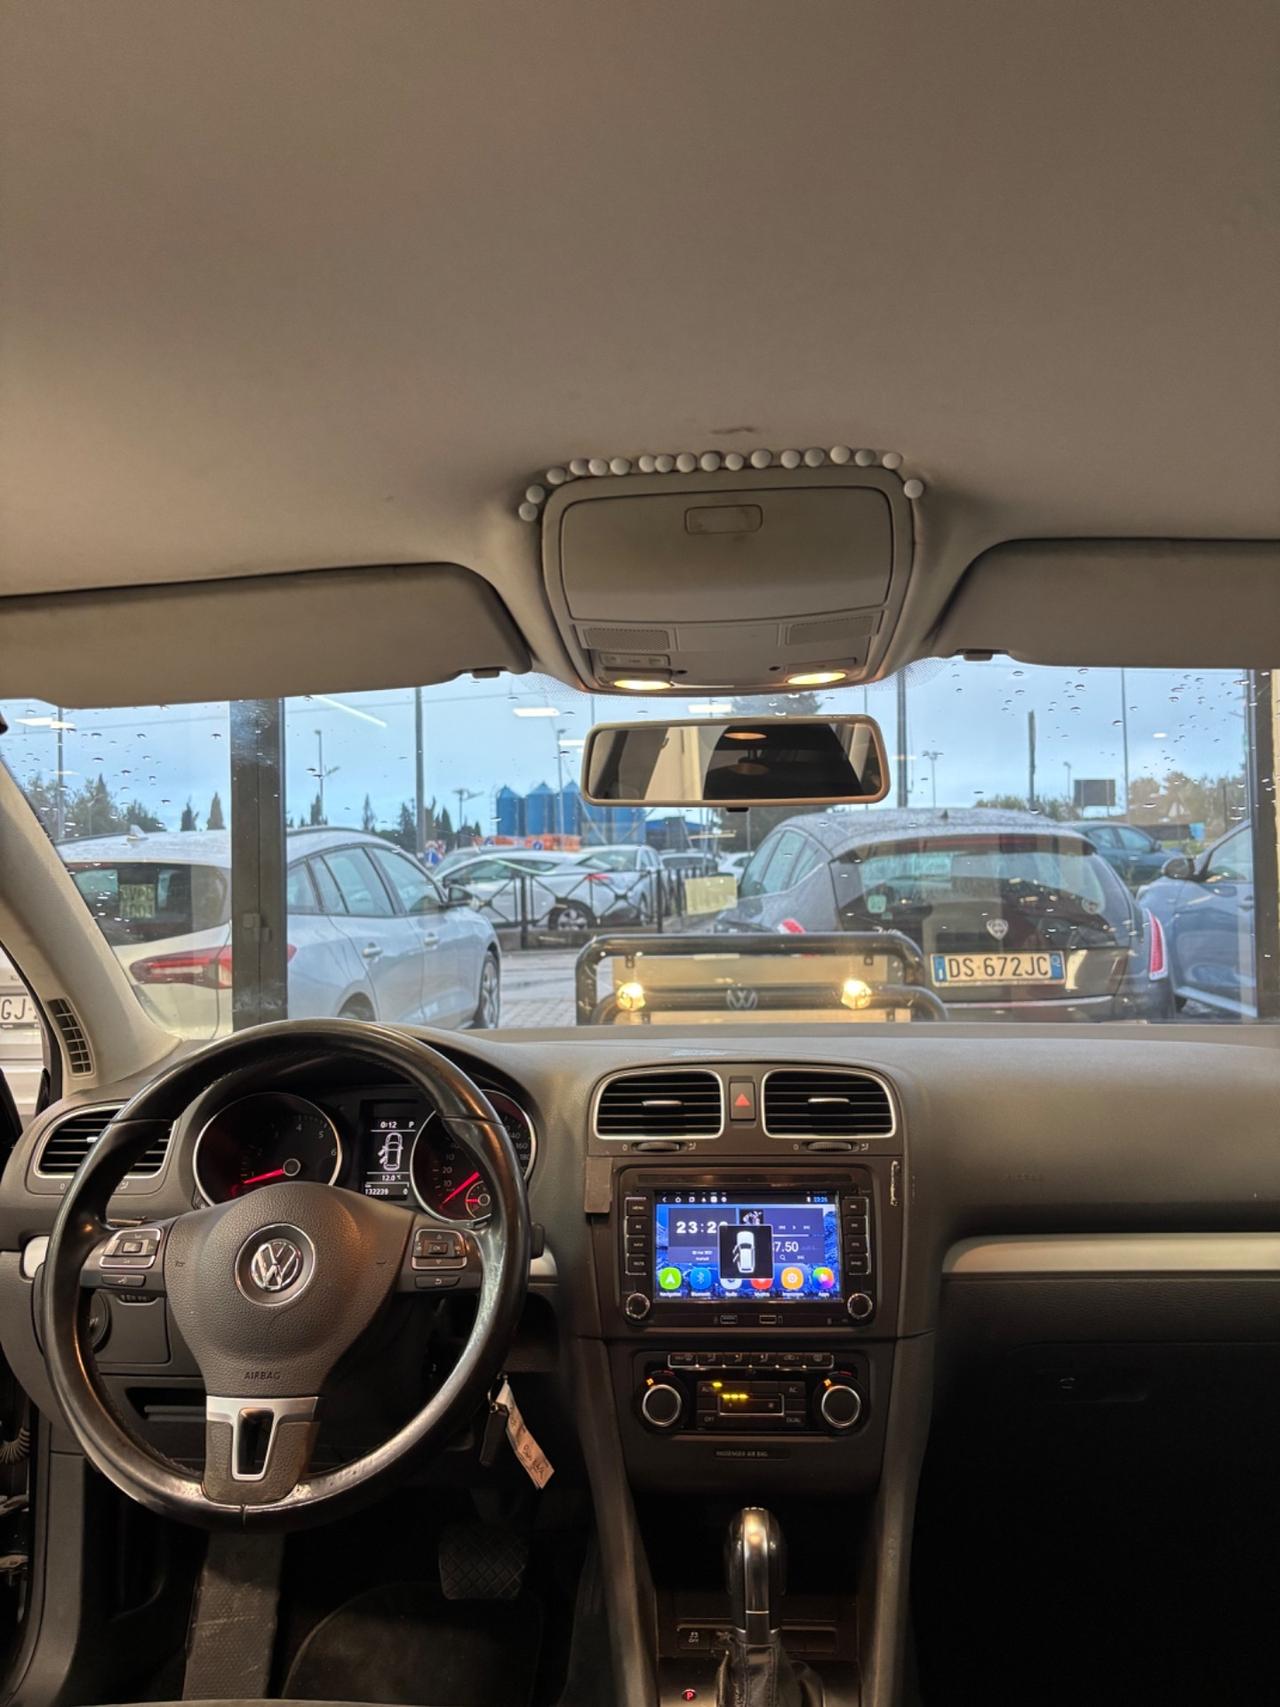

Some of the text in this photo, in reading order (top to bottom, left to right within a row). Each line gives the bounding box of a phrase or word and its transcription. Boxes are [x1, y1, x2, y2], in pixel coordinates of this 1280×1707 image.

[948, 956, 1049, 978] DS 672JC
[1, 998, 26, 1020] GJ
[772, 1241, 799, 1252] 7.50
[244, 1371, 281, 1380] AIRBAG
[686, 1691, 694, 1700] P
